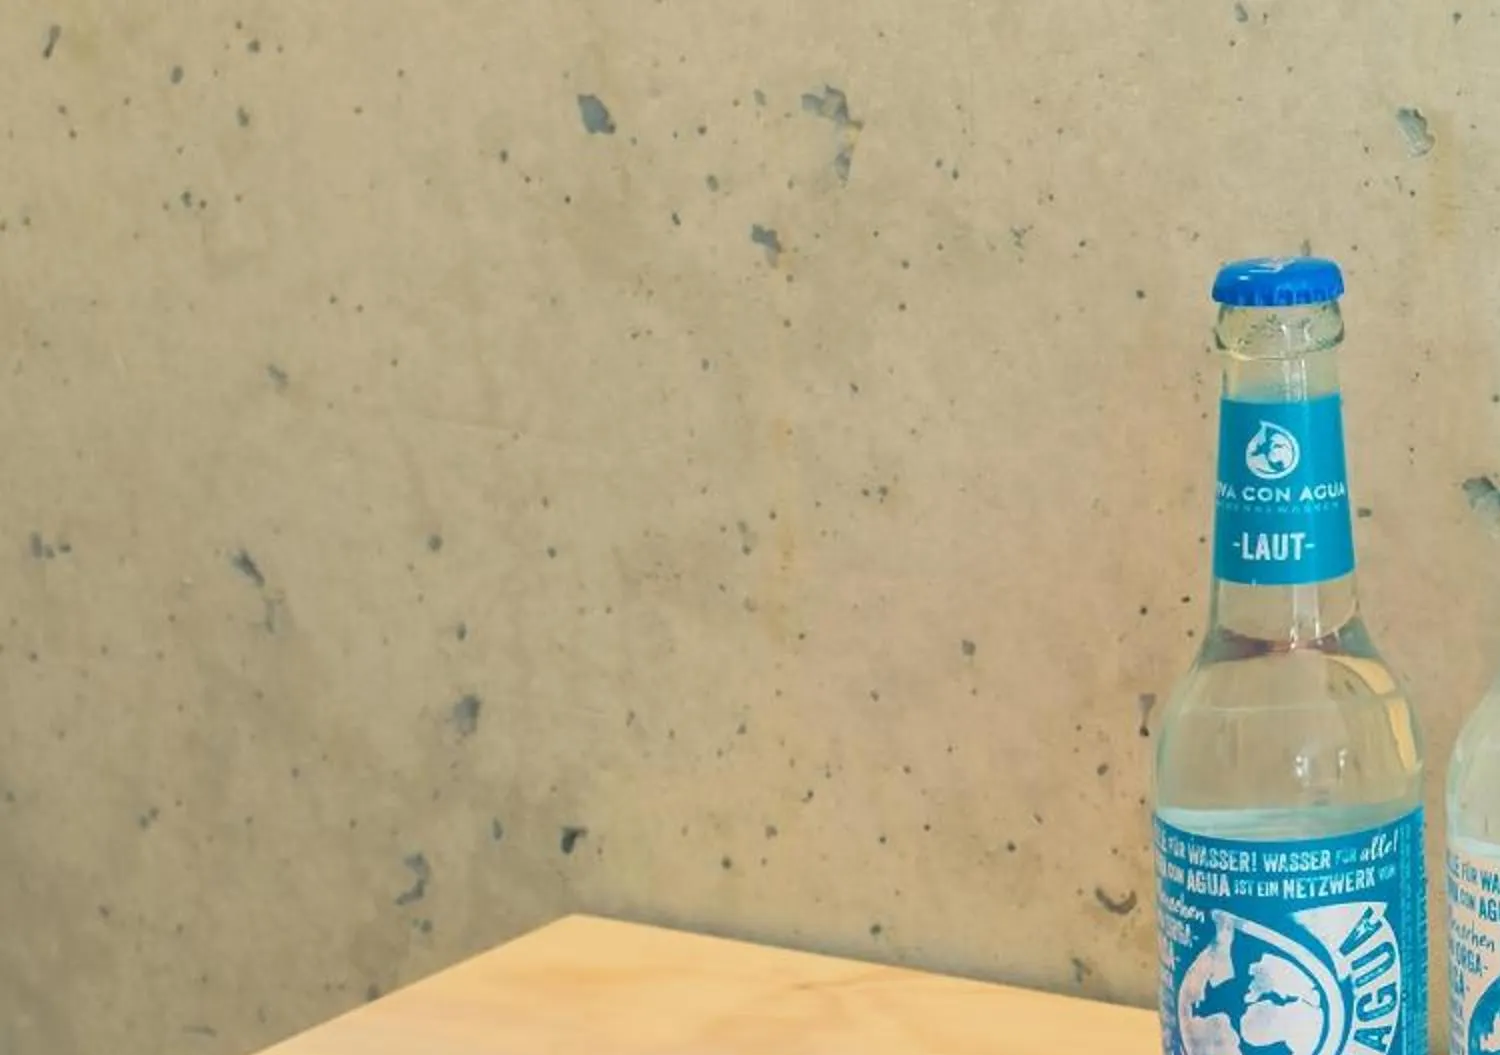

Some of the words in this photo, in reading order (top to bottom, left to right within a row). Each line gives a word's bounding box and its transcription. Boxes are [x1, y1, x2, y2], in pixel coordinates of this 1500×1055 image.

[1241, 485, 1292, 503] CON
[1299, 481, 1346, 502] AGUA
[1187, 838, 1258, 873] WASSER!
[1262, 849, 1332, 873] WASSER
[1186, 870, 1231, 898] AGUA
[1233, 879, 1255, 897] IST
[1257, 880, 1280, 898] EIN
[1282, 866, 1376, 900] NETZWERK
[1338, 905, 1399, 1053] AGUA
